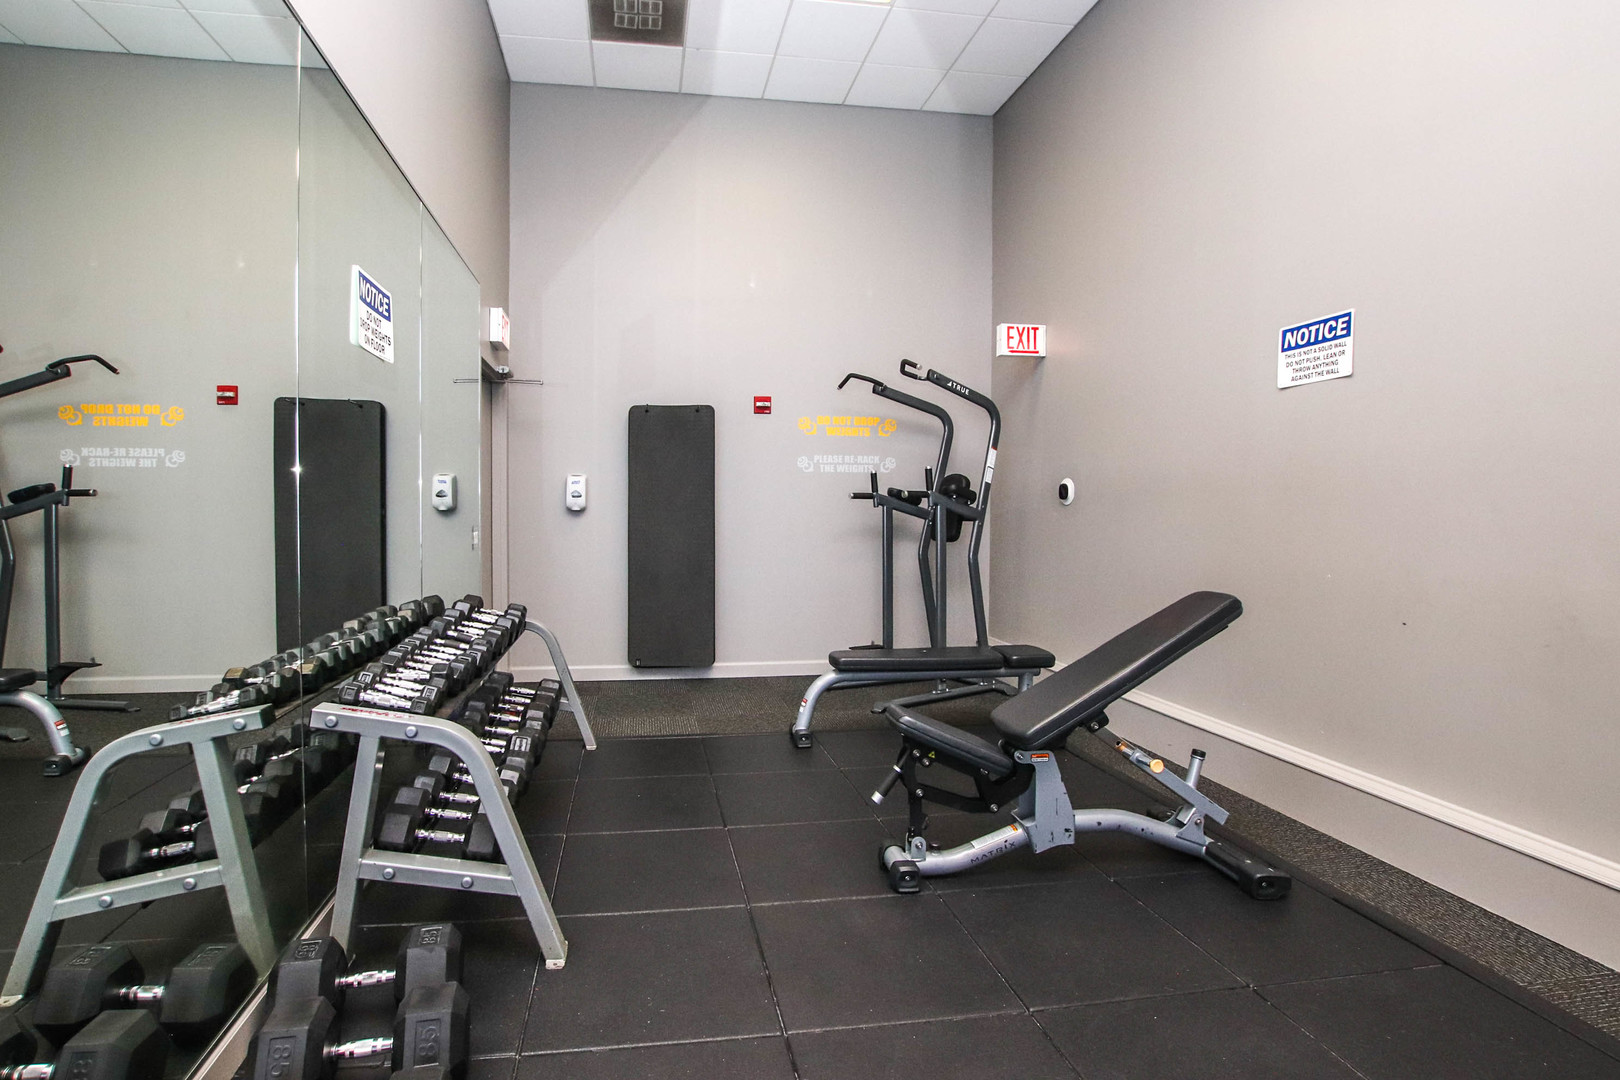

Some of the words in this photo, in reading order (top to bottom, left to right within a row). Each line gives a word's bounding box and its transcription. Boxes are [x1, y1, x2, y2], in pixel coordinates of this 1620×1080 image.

[360, 277, 389, 317] NOTICE
[366, 310, 372, 323] DO
[373, 315, 382, 329] NOT
[360, 317, 370, 332] DROP
[371, 326, 391, 346] WEIGHTS
[1007, 326, 1039, 350] EXIT
[1284, 316, 1349, 349] NOTICE
[364, 333, 370, 347] ON
[371, 338, 385, 355] FLOOR
[1318, 344, 1333, 352] SOLID
[1334, 341, 1347, 349] WALL
[1323, 352, 1337, 360] LEAN
[1292, 365, 1311, 374] THROW
[1312, 360, 1338, 370] ANYTHING
[1291, 372, 1313, 382] AGAINST
[1326, 367, 1339, 375] WALL
[952, 382, 970, 396] TRUE
[817, 415, 831, 425] DO
[833, 415, 852, 426] NOT
[854, 416, 880, 426] DROP
[826, 426, 871, 437] WEIGHTS
[813, 454, 843, 464] PLEASE
[844, 455, 880, 464] RE-RACK
[819, 464, 836, 473] THE
[836, 464, 873, 473] WEIGHTS
